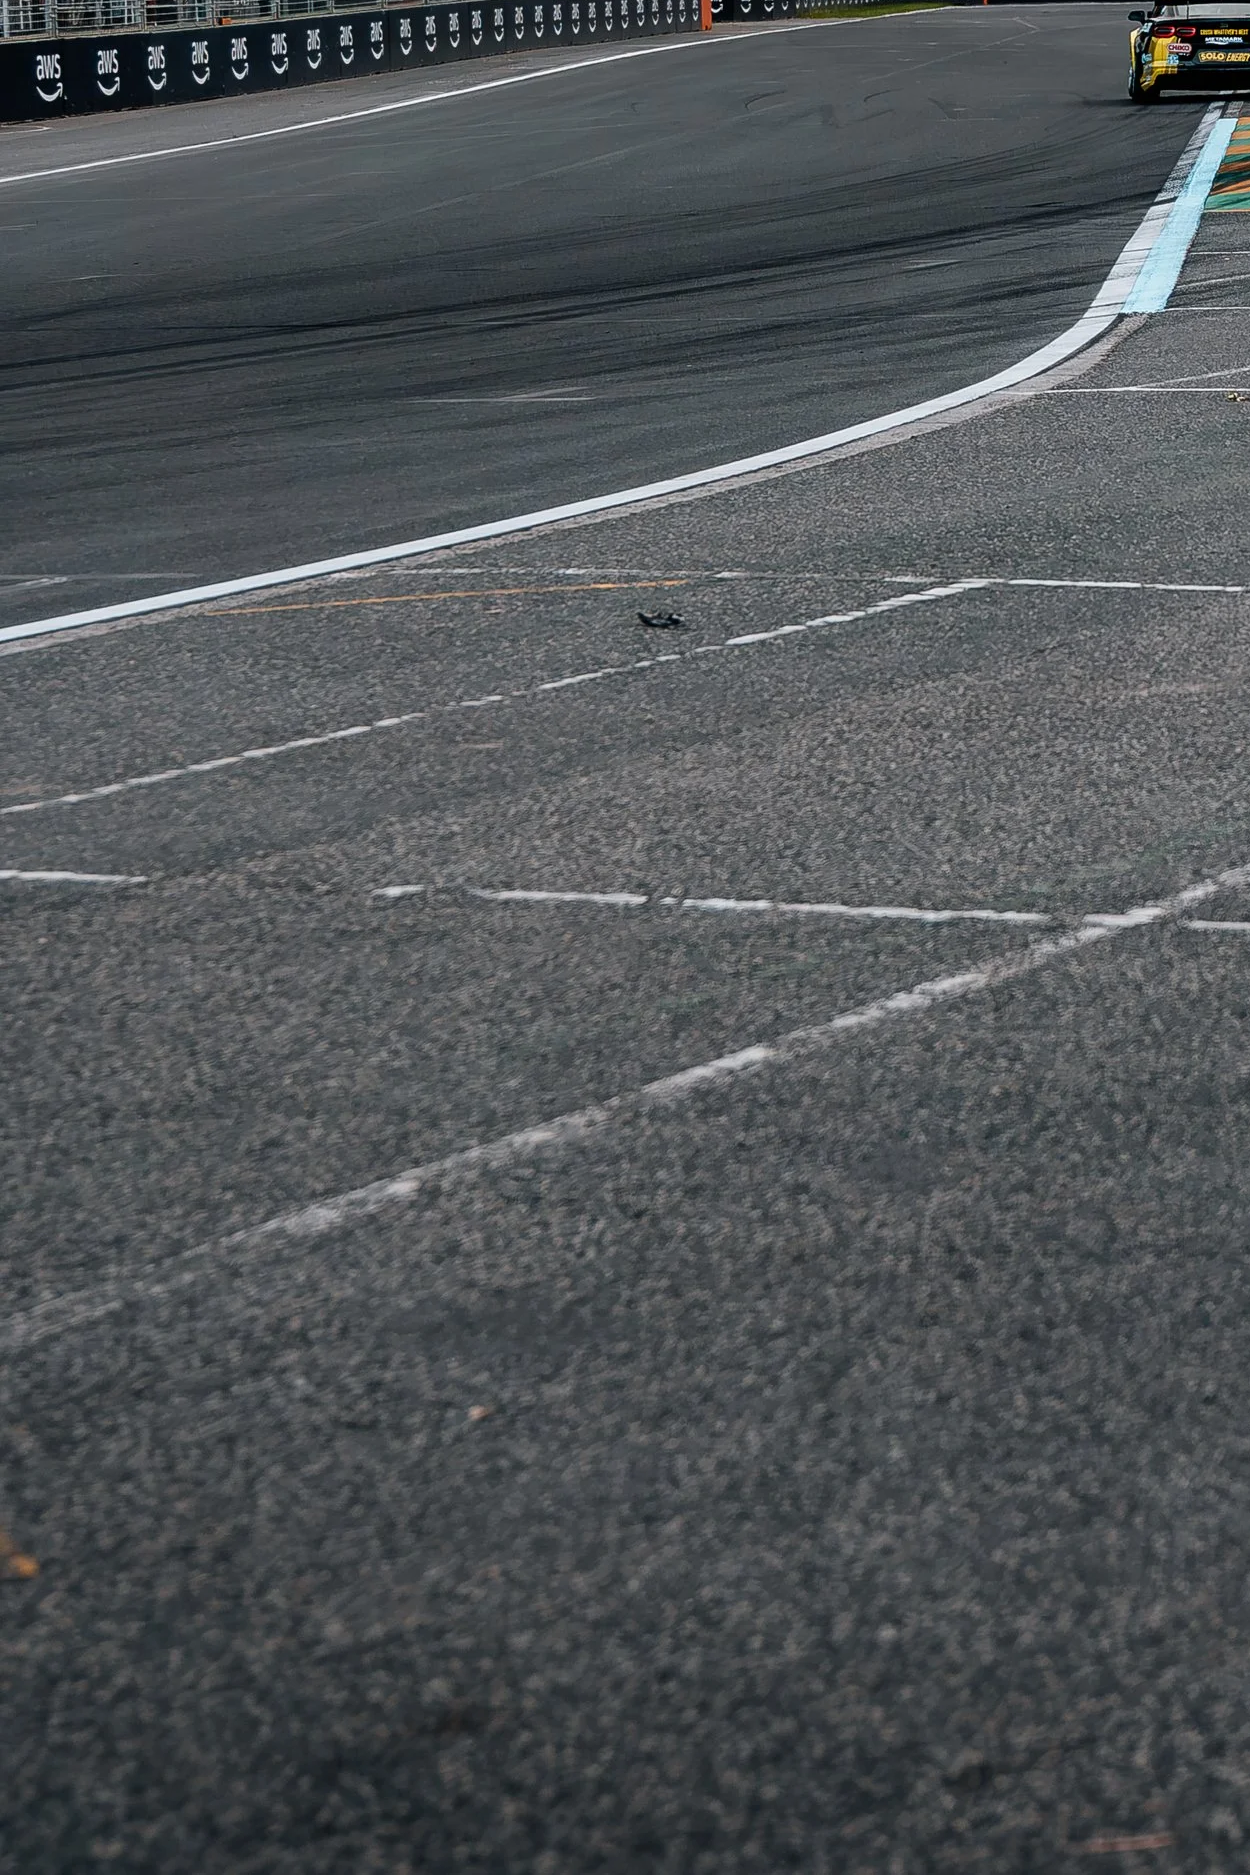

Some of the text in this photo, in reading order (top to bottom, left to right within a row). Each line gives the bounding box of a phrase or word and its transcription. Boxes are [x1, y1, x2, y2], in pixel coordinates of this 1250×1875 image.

[191, 40, 209, 65] aws
[231, 37, 248, 61] aws
[271, 33, 287, 56] aws
[1200, 52, 1225, 61] SOLO
[36, 54, 61, 80] aws
[97, 49, 119, 75] aws
[147, 45, 165, 70] aws
